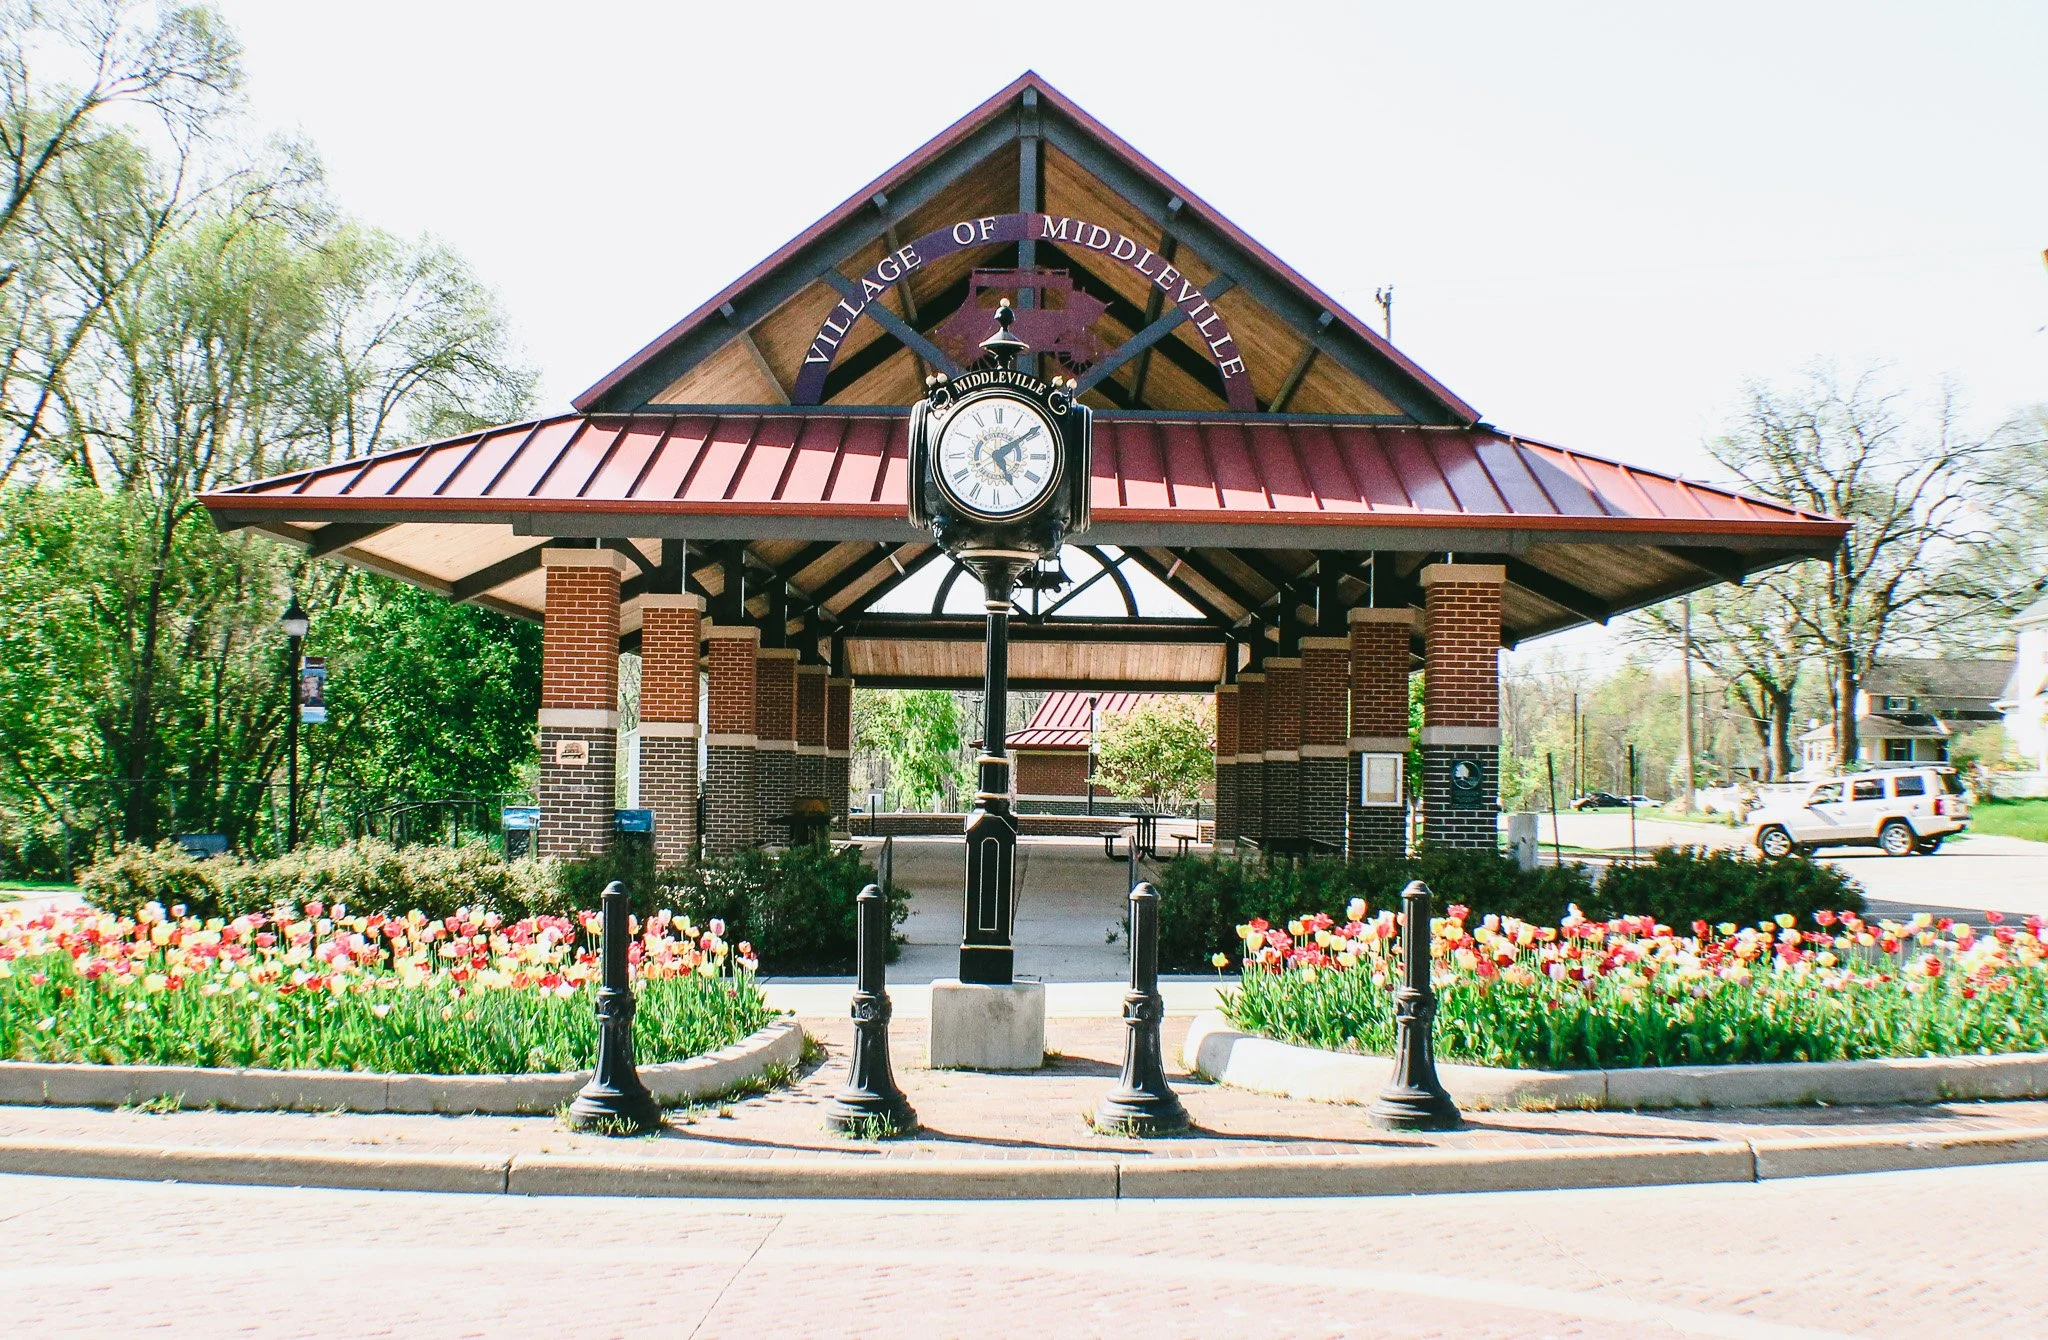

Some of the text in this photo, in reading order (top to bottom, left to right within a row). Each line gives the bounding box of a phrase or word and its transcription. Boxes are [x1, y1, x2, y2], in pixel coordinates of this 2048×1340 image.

[804, 214, 1246, 380] VILLAGE OF MIDDLEVILLE
[952, 371, 1047, 396] MIDDLEVILLE
